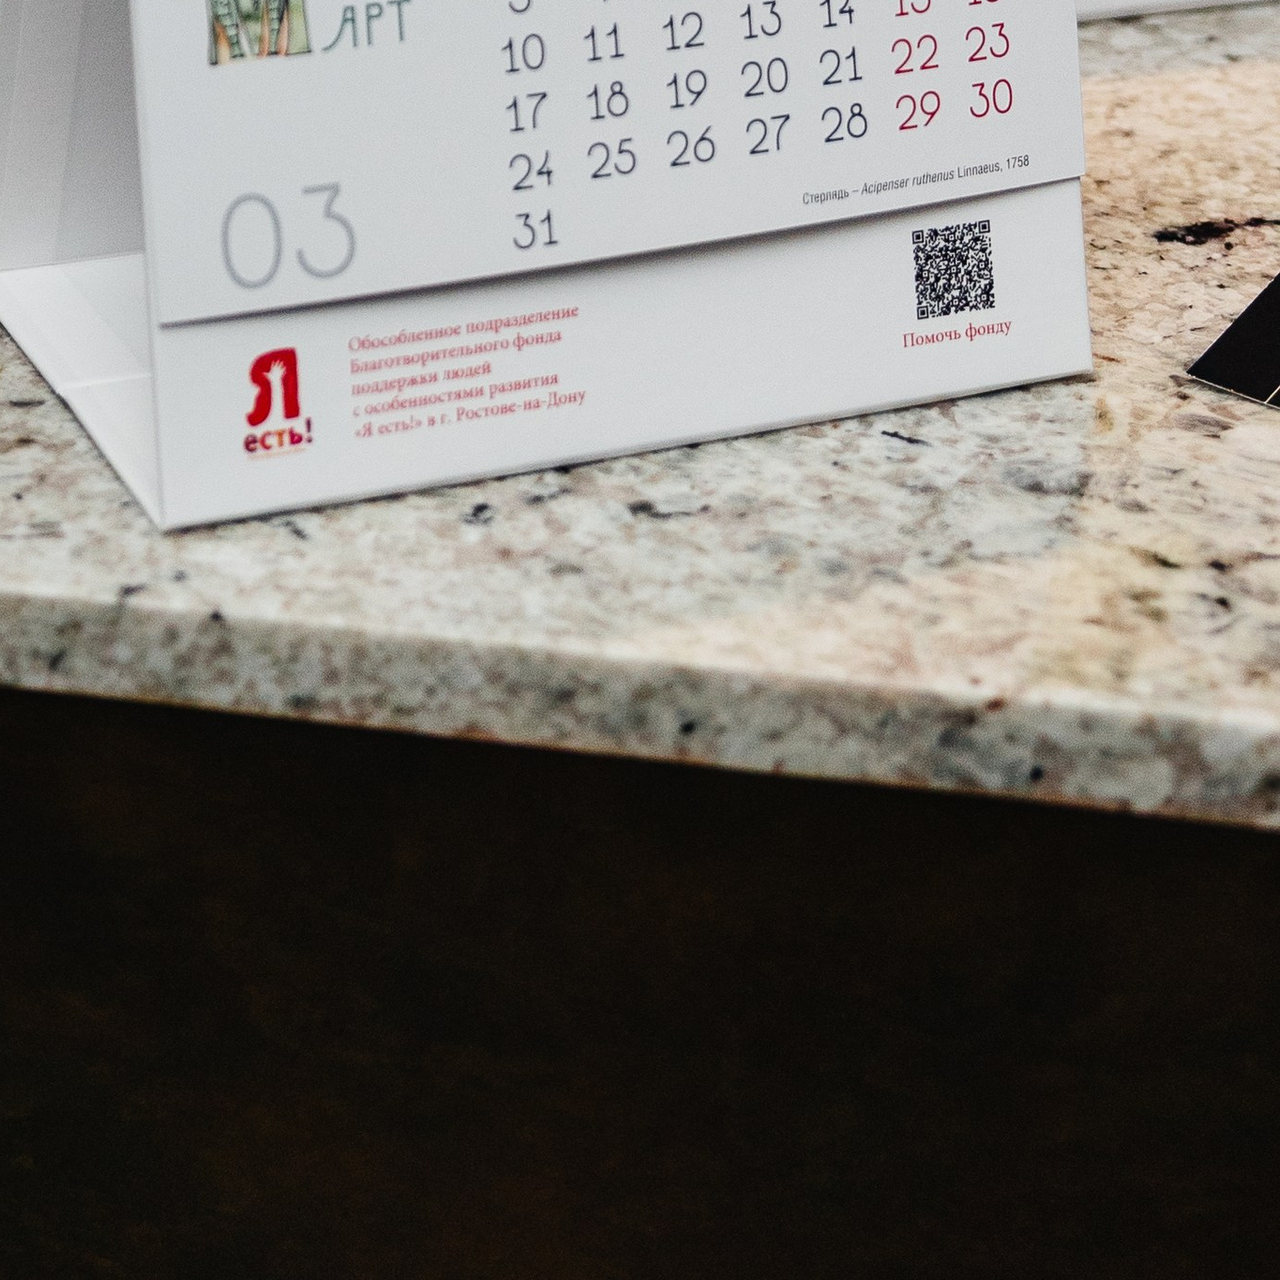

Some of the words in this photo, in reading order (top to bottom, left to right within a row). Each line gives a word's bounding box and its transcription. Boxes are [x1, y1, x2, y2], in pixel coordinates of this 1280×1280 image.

[502, 34, 545, 73] 10
[585, 23, 624, 62] 11
[663, 12, 704, 51] 12
[740, 0, 782, 39] 13
[507, 92, 547, 132] 17
[587, 81, 629, 120] 18
[667, 70, 707, 109] 19
[741, 57, 788, 97] 20
[819, 46, 862, 86] 21
[891, 34, 939, 74] 22
[965, 22, 1010, 62] 23
[510, 151, 553, 191] 24
[588, 138, 636, 179] 25
[667, 126, 715, 167] 26
[746, 114, 790, 155] 27
[821, 103, 868, 143] 28
[896, 90, 941, 131] 29
[970, 79, 1013, 118] 30
[861, 176, 909, 196] Acipenser
[912, 169, 955, 187] ruthenus
[957, 160, 1003, 180] Linnaeus,
[1006, 154, 1030, 170] 1758
[220, 182, 357, 289] 03
[514, 210, 558, 249] 31
[348, 323, 462, 353] Обособленное
[465, 306, 580, 336] подразделение
[349, 339, 510, 374] Благотворительного
[512, 329, 562, 352] фонда
[902, 326, 962, 348] Помочь
[965, 320, 1013, 341] фонду
[246, 347, 300, 427] Я
[351, 369, 439, 397] поддержки
[442, 360, 492, 381] людей
[353, 407, 360, 418] с
[363, 386, 485, 415] особенностями
[489, 373, 560, 399] развития
[244, 417, 314, 453] есть!
[354, 421, 373, 438] «Я
[427, 416, 436, 426] в
[456, 389, 587, 421] Ростове-на-Дону
